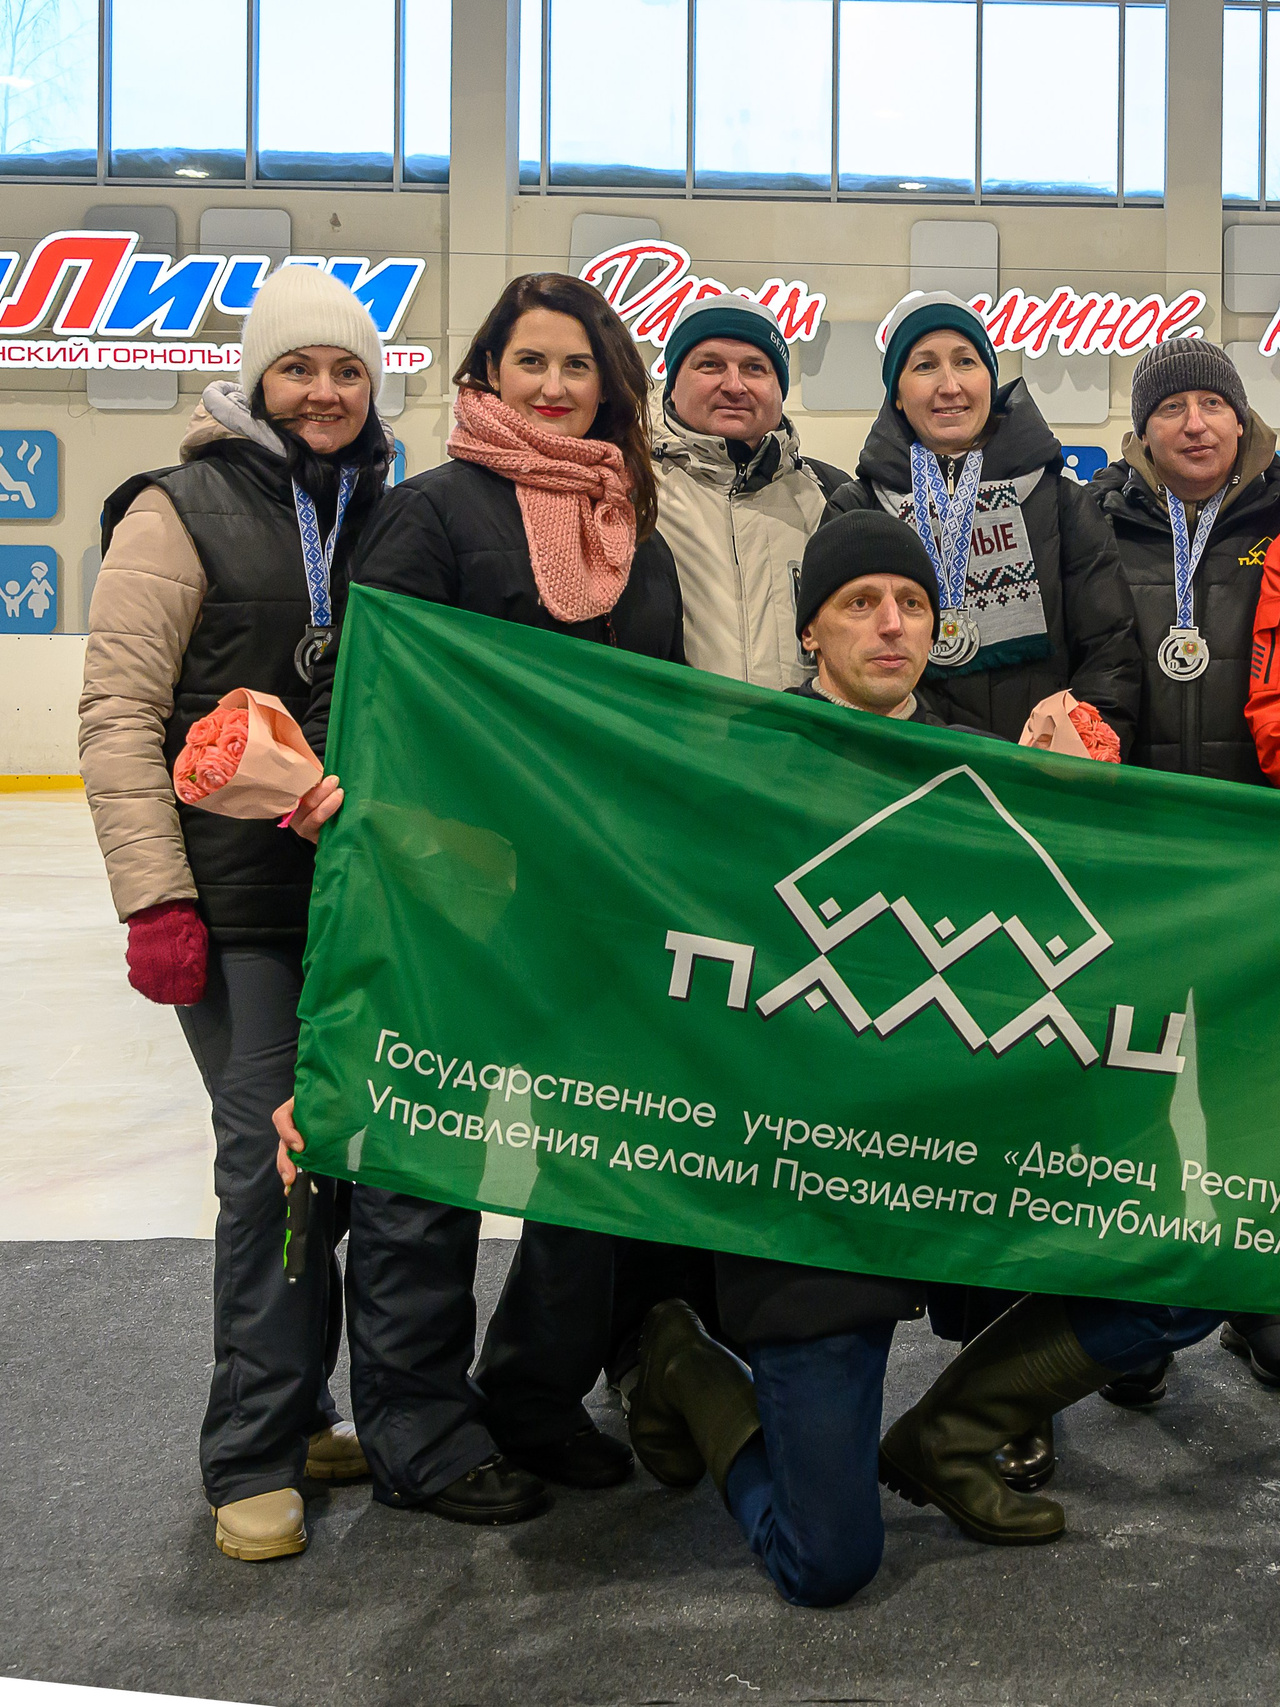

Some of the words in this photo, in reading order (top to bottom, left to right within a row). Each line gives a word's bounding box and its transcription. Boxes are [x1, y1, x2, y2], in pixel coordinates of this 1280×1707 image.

[0, 235, 423, 335] Личи
[367, 1079, 600, 1160] Управления
[609, 1140, 759, 1187] делами
[771, 1157, 998, 1216] Президента
[1008, 1187, 1222, 1247] Республики
[373, 1028, 717, 1128] Государственное
[742, 1110, 978, 1165] учреждение
[1003, 1141, 1157, 1192] «Дворец
